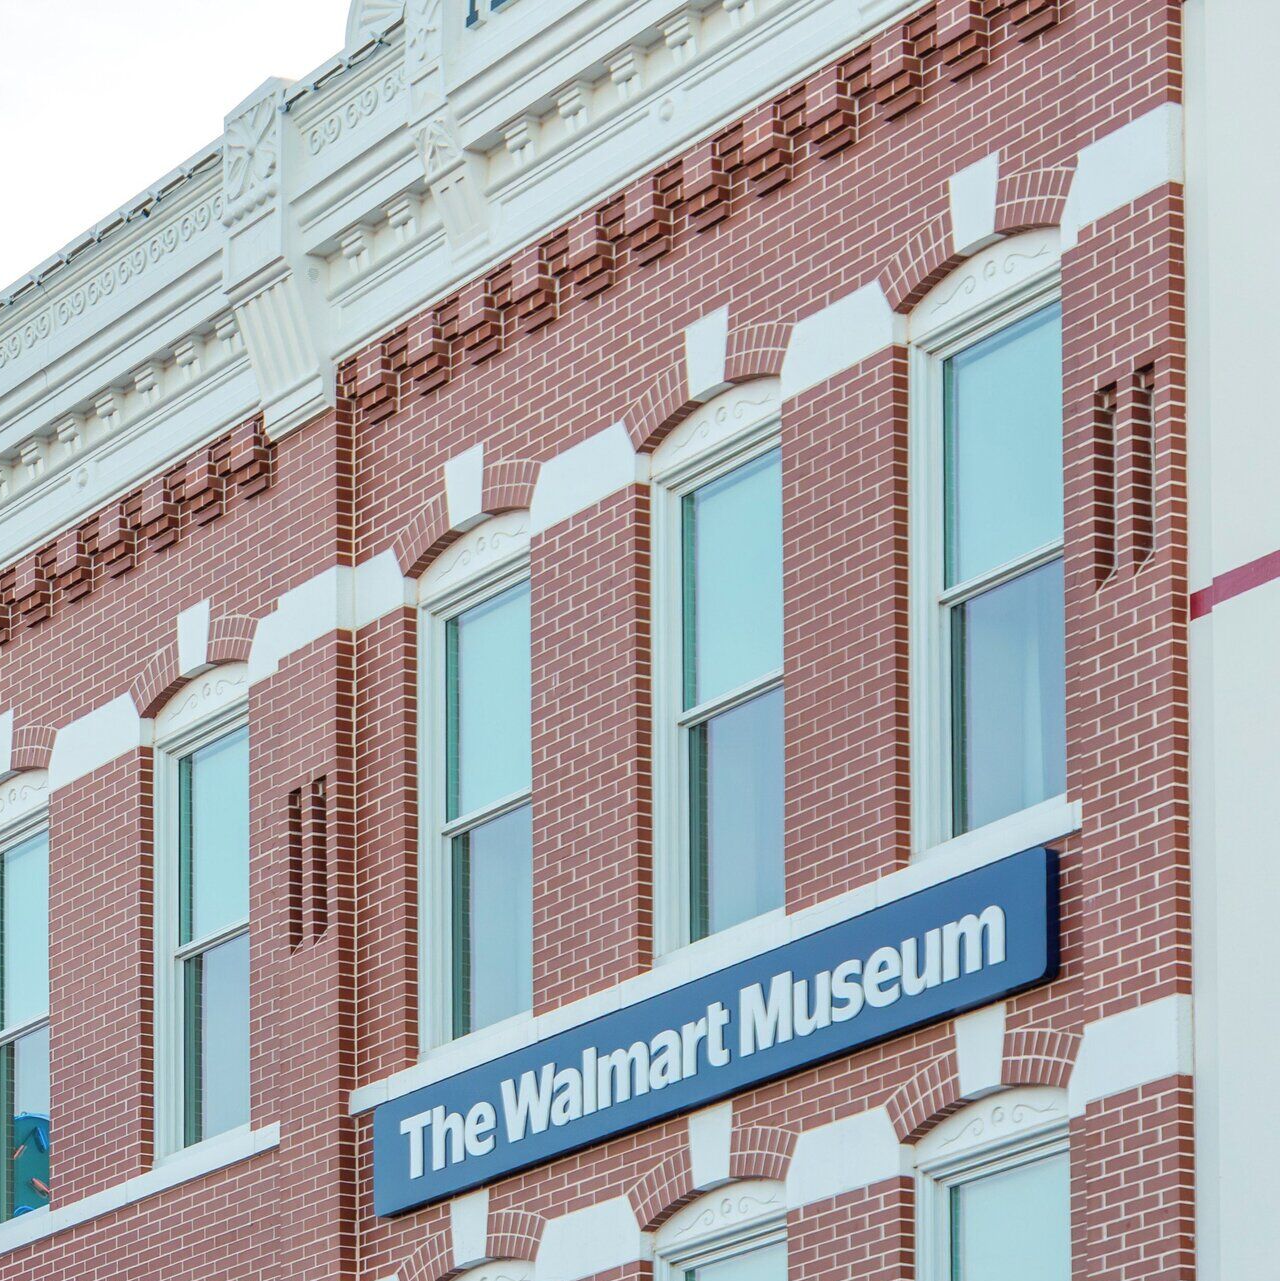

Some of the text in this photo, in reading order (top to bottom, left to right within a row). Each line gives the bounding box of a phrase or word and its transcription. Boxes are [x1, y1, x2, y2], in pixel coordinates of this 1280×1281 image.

[399, 904, 1007, 1180] The Walmart Museum
